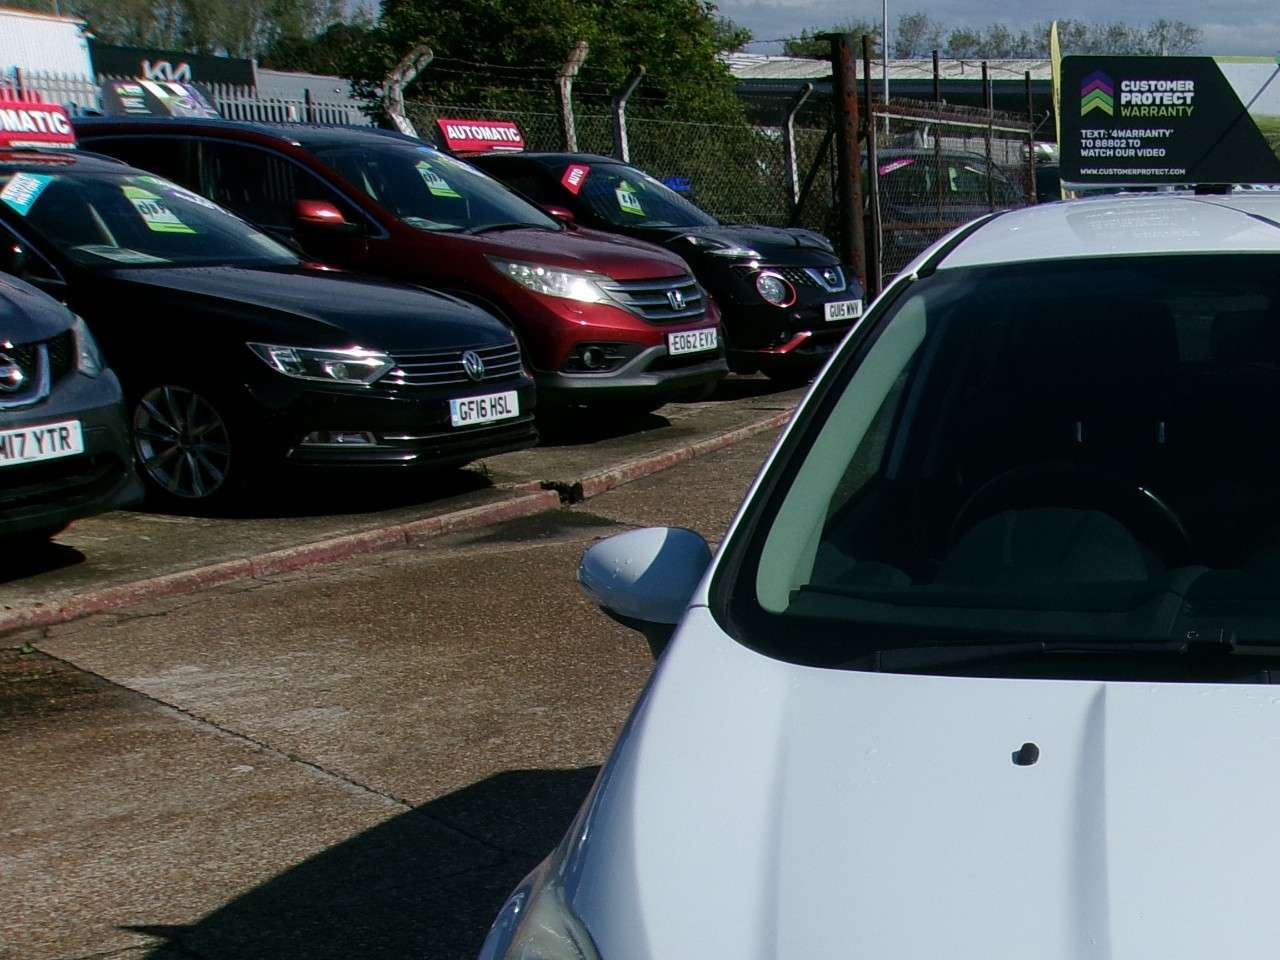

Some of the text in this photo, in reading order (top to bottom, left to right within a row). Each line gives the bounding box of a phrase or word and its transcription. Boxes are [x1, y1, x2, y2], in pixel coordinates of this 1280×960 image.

[1121, 80, 1194, 92] CUSTOMER
[1121, 92, 1195, 105] PROTECT
[1121, 106, 1194, 118] WARRANTY
[448, 124, 521, 142] AUTOMATIC
[1081, 129, 1109, 138] TEXT:
[1081, 140, 1141, 148] TO 88802 TO
[1080, 149, 1166, 157] WATCH OUR VIDEO
[567, 168, 585, 187] AUTO
[459, 395, 512, 421] GF16 HSL
[32, 426, 72, 455] YTR
